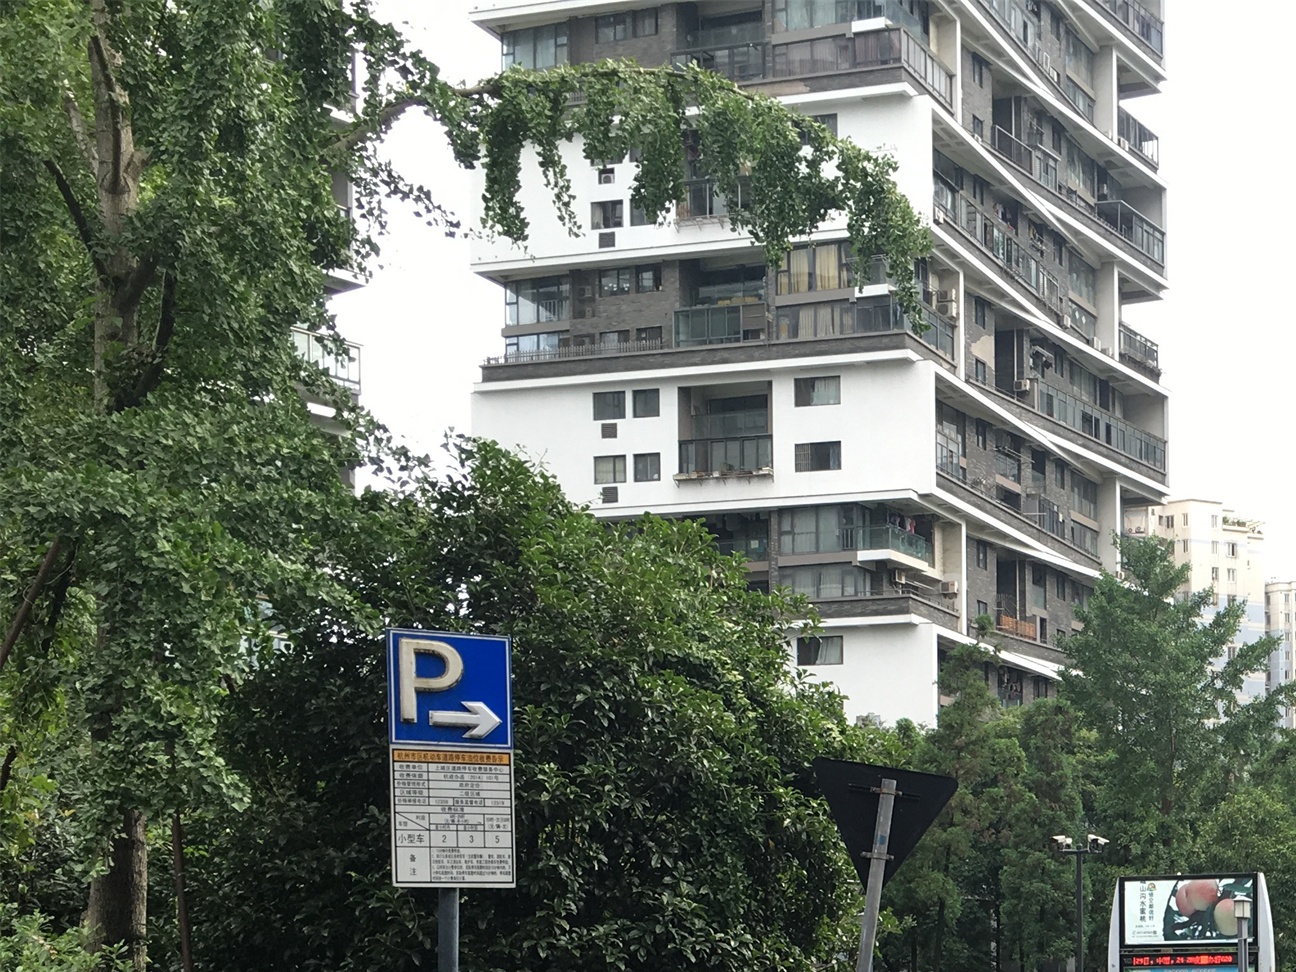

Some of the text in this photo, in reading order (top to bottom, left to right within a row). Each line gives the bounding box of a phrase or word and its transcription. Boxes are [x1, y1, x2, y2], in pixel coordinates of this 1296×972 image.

[399, 638, 464, 723] P
[398, 833, 425, 844] 小型车
[441, 834, 448, 843] 2
[469, 834, 474, 844] 3
[495, 835, 500, 844] 5
